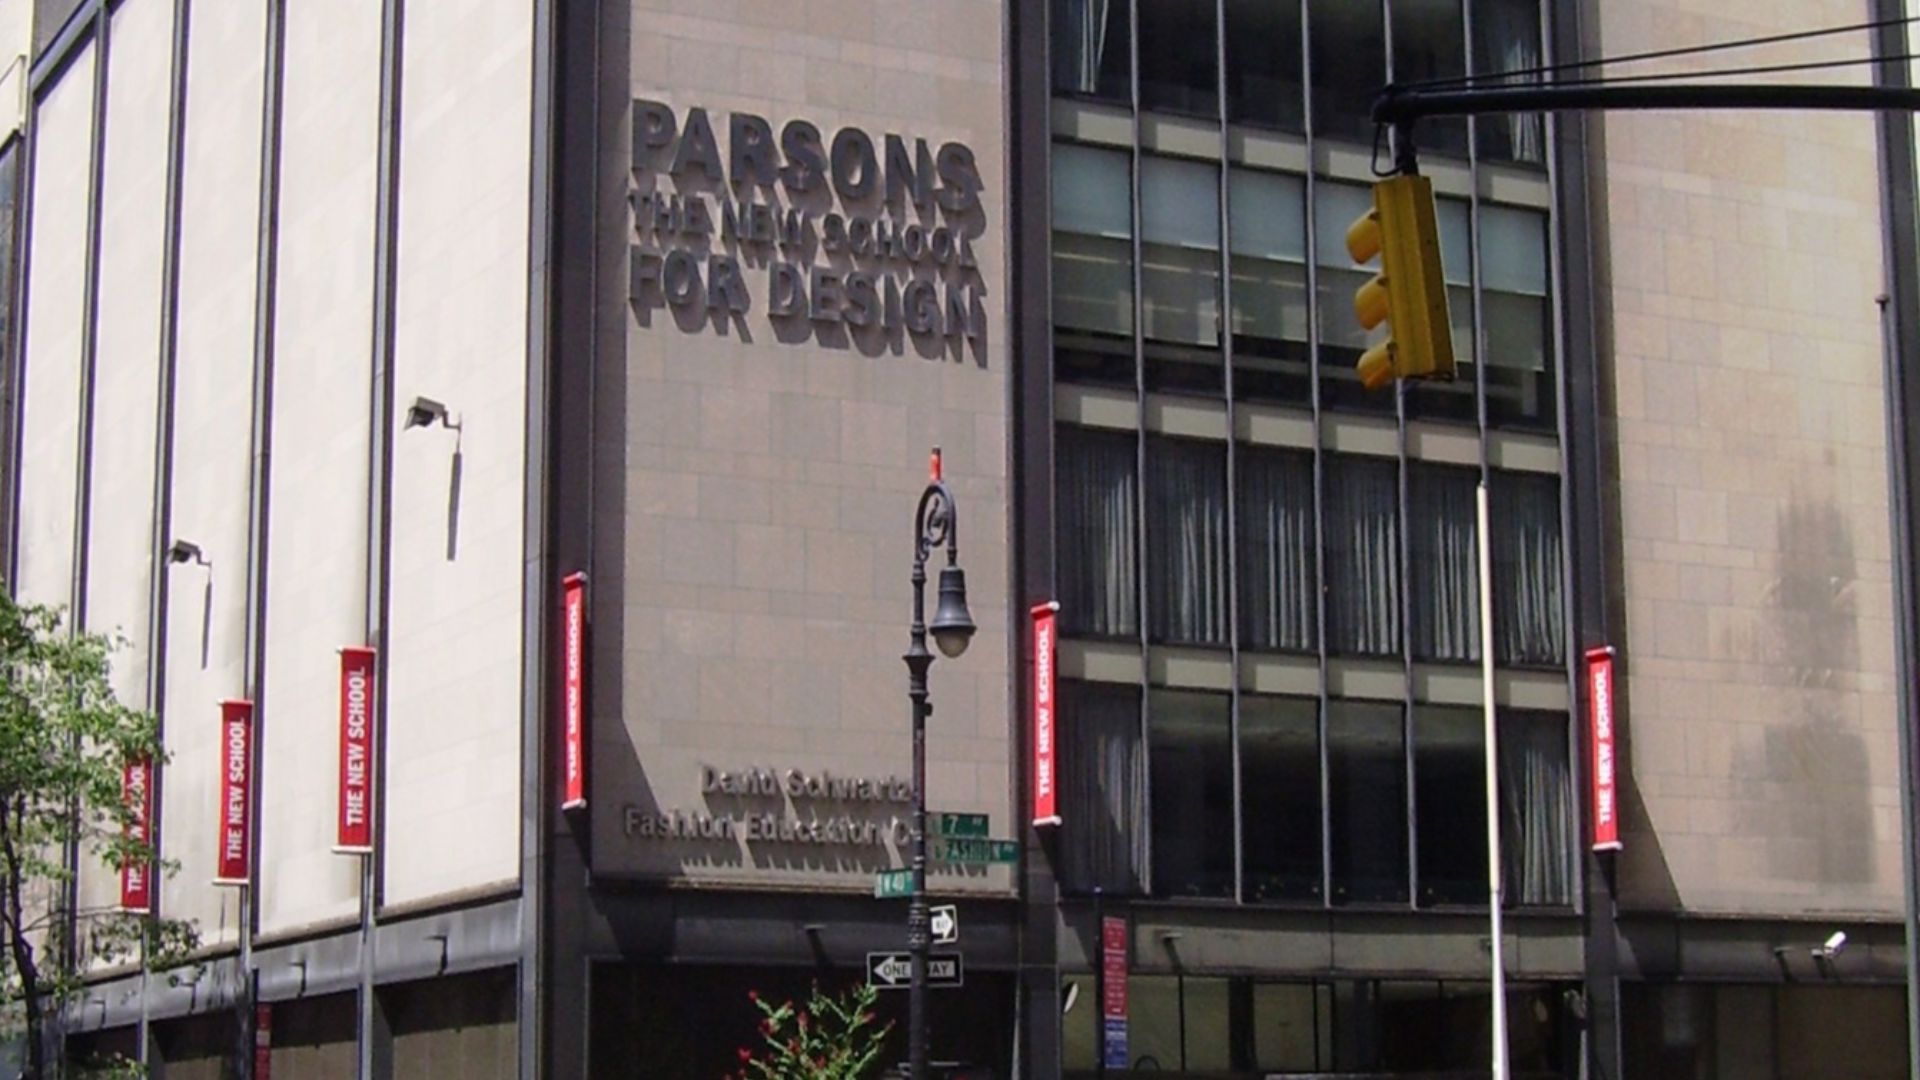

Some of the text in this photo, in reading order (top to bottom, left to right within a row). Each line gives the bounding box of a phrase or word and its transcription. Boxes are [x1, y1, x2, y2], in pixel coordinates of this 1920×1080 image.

[631, 99, 984, 211] PARSONS
[628, 190, 976, 269] THE NEW SCHOOL
[630, 245, 978, 339] FOR DESIGN
[346, 667, 366, 826] THE NEW SCHOOL
[1039, 624, 1050, 798] THE NEW SCHOOL
[1595, 668, 1612, 826] THE NEW SCHOOL
[227, 717, 246, 861] THE NEW SCHOOL
[624, 807, 735, 840] Fashion
[746, 812, 884, 846] Education
[702, 765, 913, 803] David Schwartz
[948, 816, 960, 834] 7
[883, 963, 907, 976] ONE
